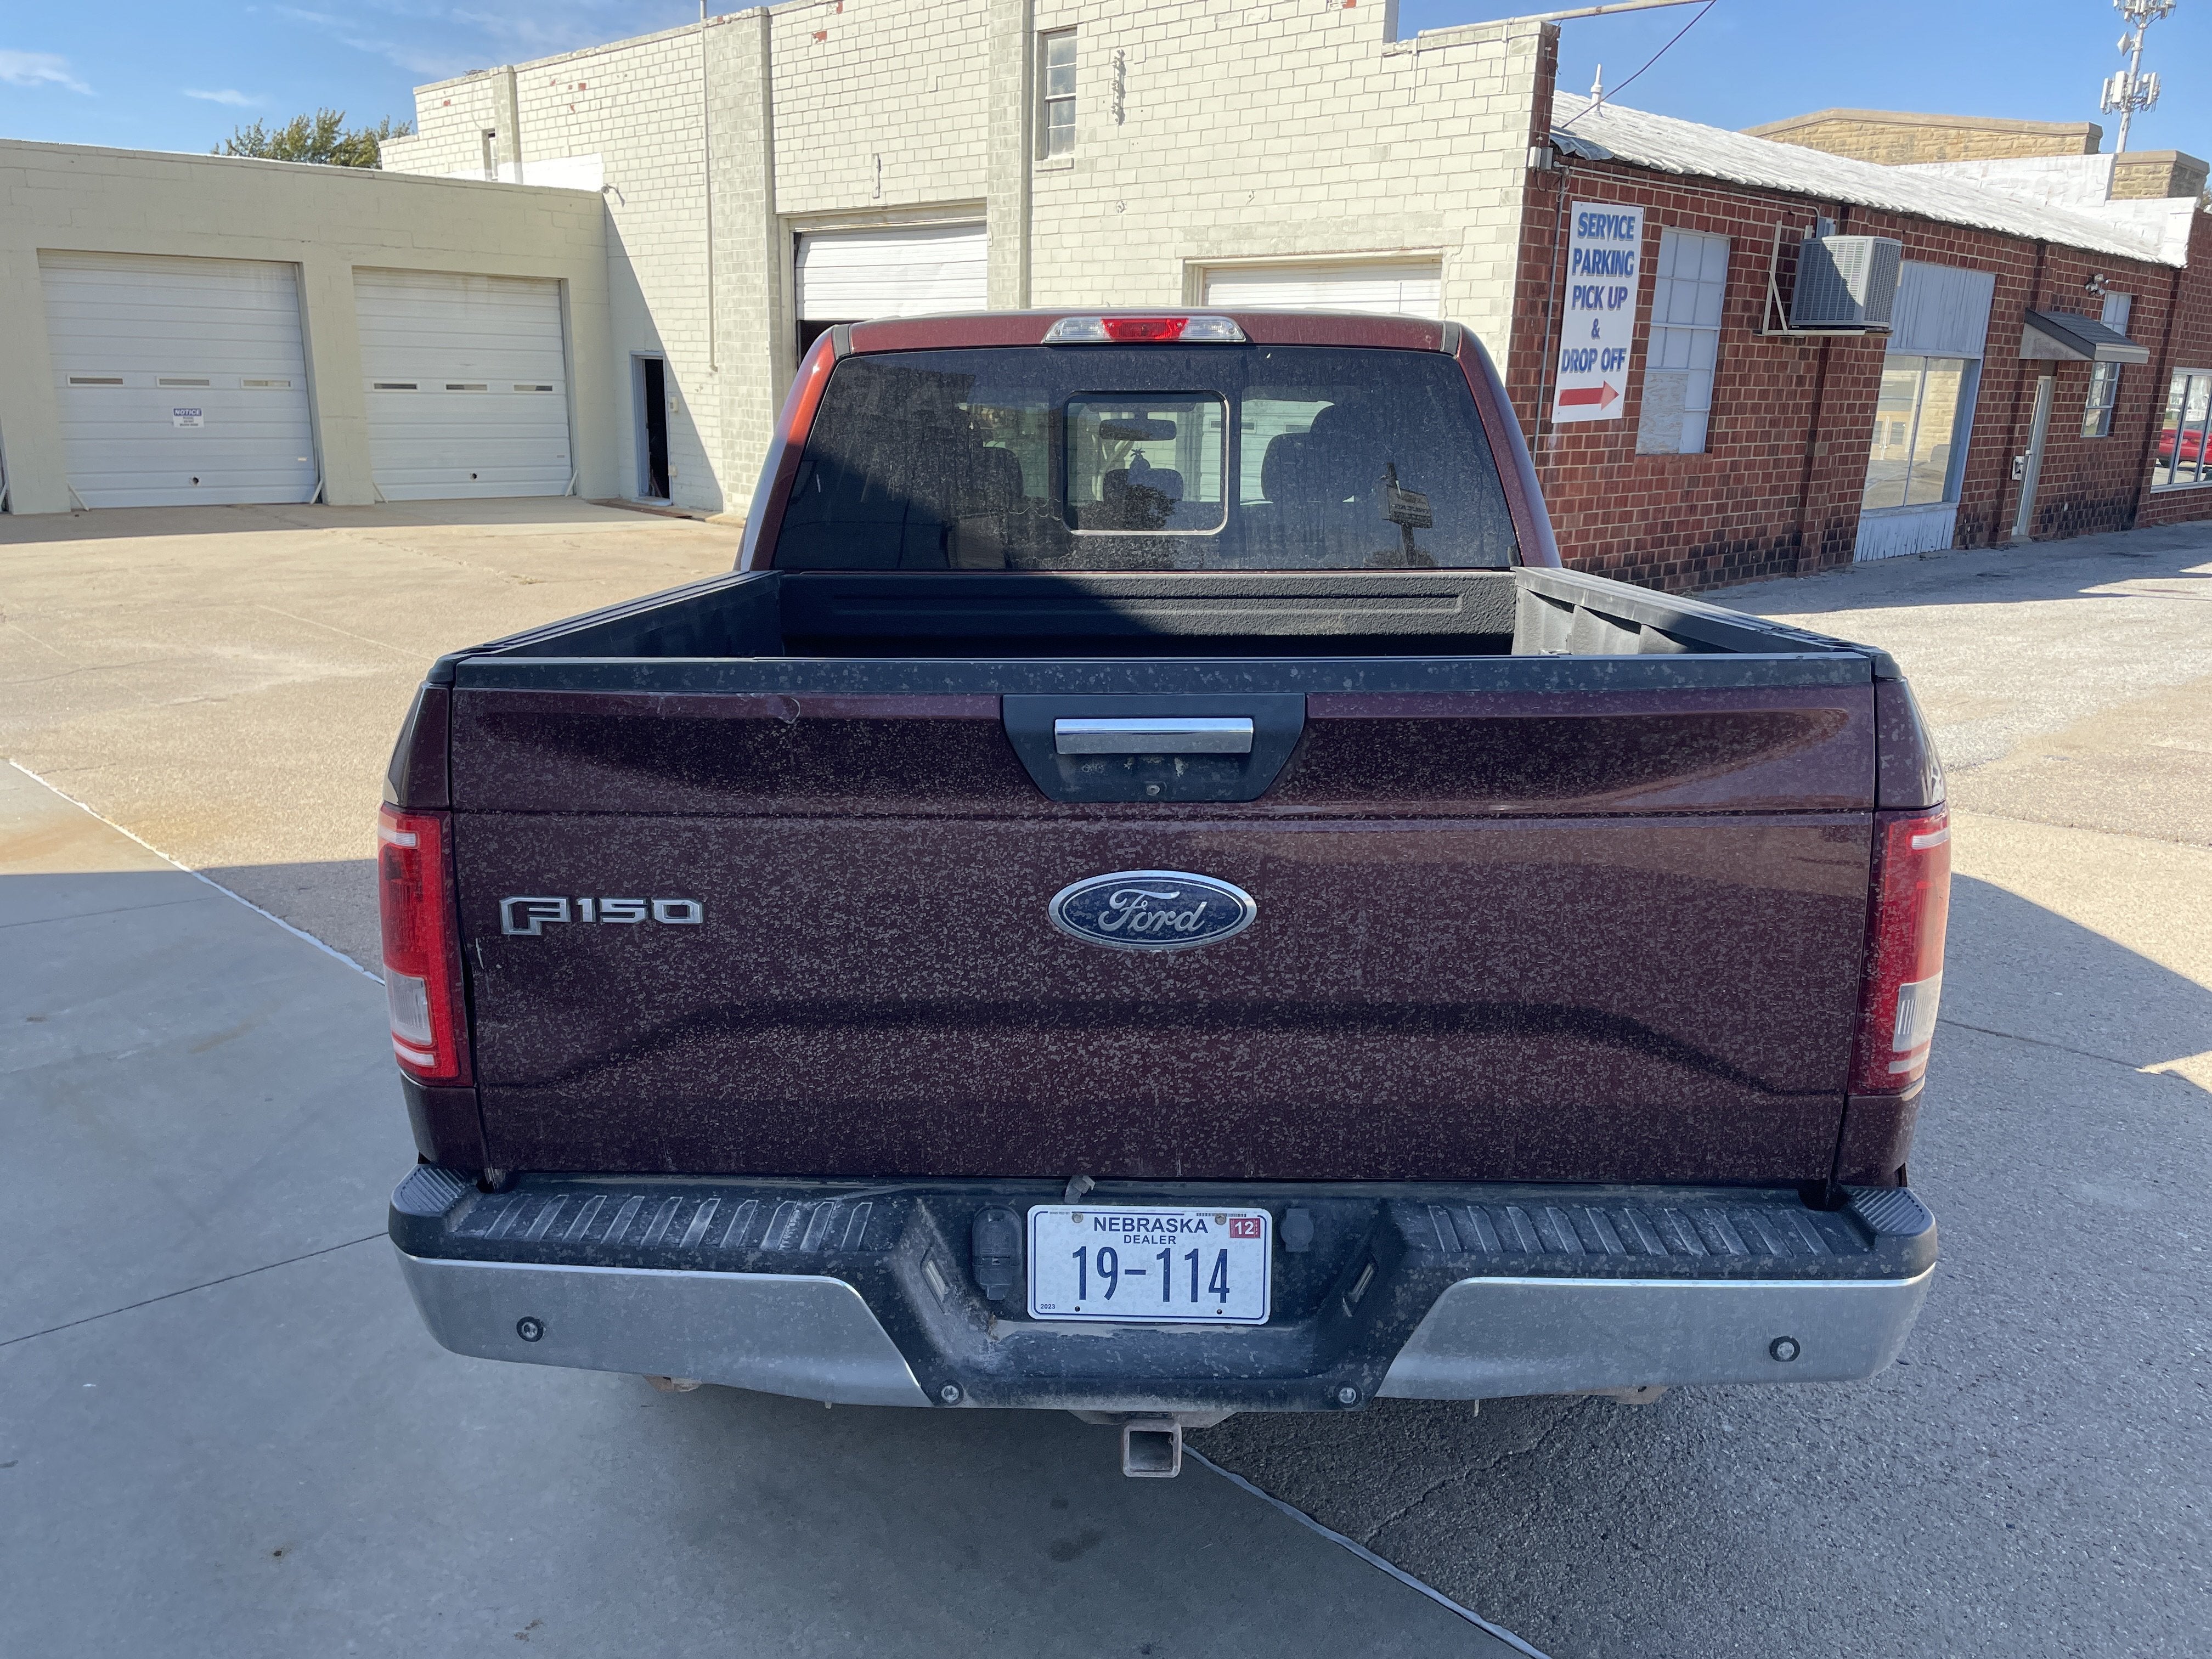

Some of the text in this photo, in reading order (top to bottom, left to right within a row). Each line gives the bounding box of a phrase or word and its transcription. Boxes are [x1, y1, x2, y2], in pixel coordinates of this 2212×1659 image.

[1577, 211, 1635, 241] SERVICE
[1572, 247, 1634, 277] PARKING
[1571, 285, 1628, 311] PICK UP
[1592, 318, 1600, 340] &
[1561, 347, 1627, 374] DROP OFF
[1098, 889, 1207, 933] Ford
[1093, 1216, 1209, 1234] NEBRASKA
[1235, 1221, 1254, 1235] 12
[1124, 1234, 1177, 1244] DEALER
[1072, 1245, 1230, 1304] 19-114
